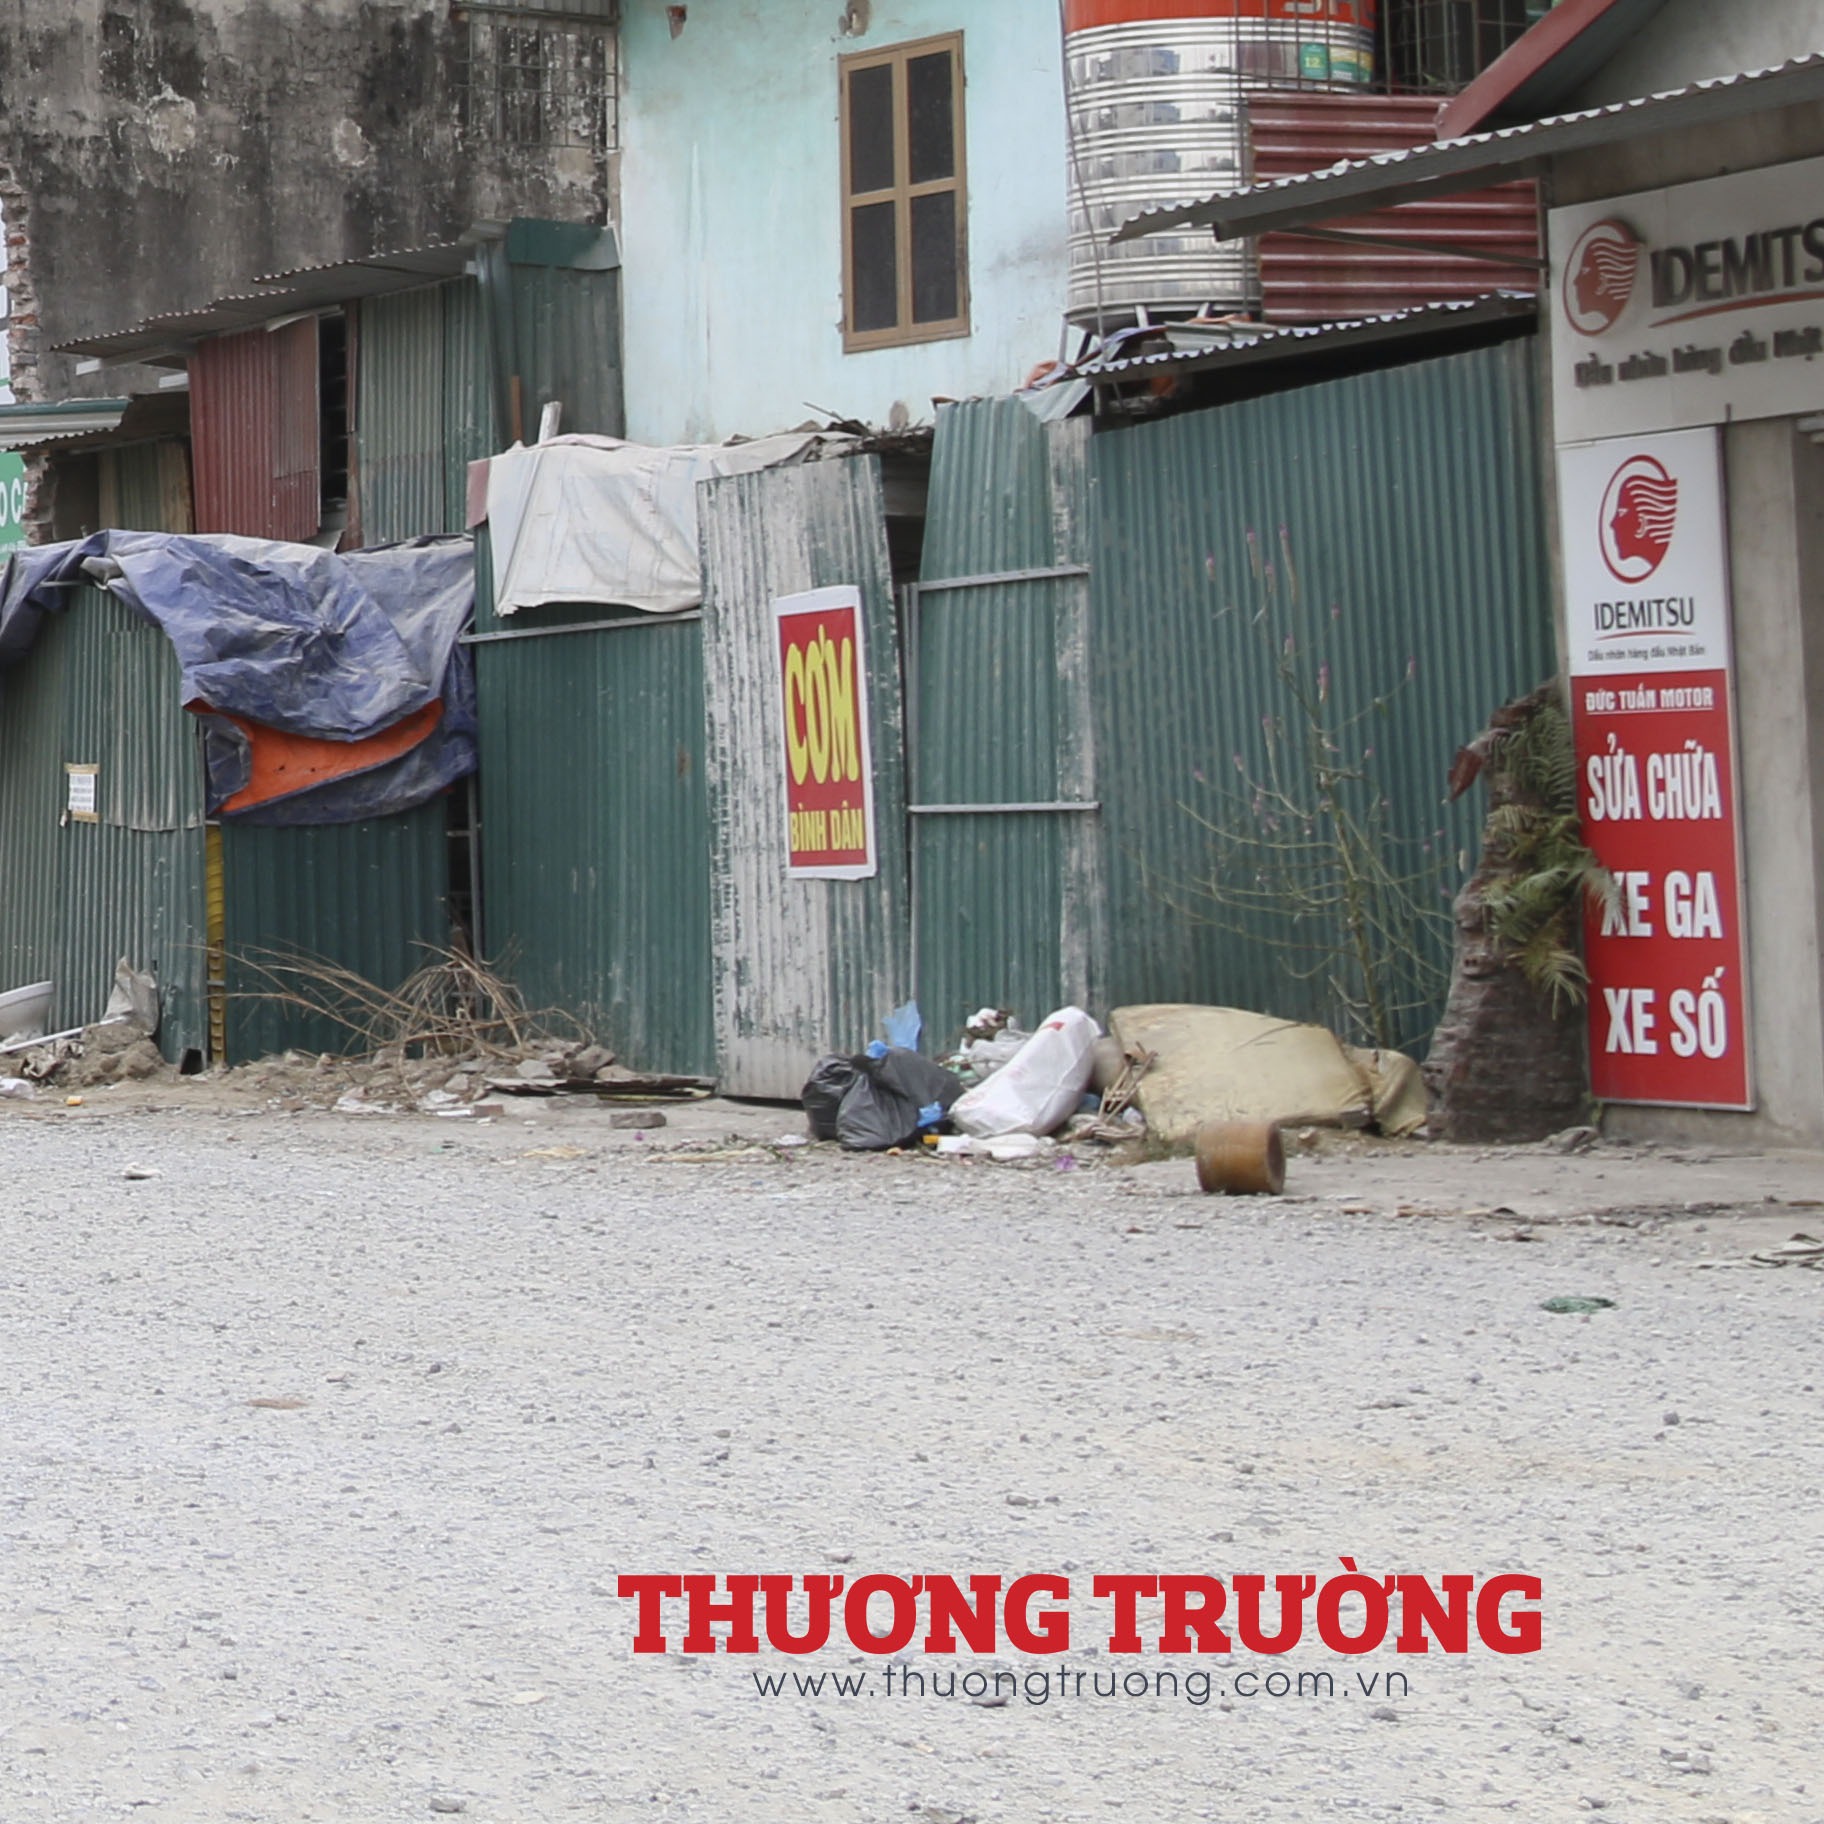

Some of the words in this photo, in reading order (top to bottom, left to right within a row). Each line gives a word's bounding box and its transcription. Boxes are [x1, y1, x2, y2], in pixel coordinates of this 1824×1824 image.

[1594, 596, 1695, 631] IDEMITSU
[785, 624, 859, 785] CƠM
[1659, 686, 1714, 708] MOTOR
[1587, 733, 1641, 821] SỬA
[1647, 739, 1723, 821] CHỮA
[790, 802, 827, 852] BÌNH
[830, 800, 864, 851] DÂN
[1664, 870, 1723, 939] GA
[1603, 988, 1657, 1054] XE
[1669, 966, 1727, 1059] SỐ
